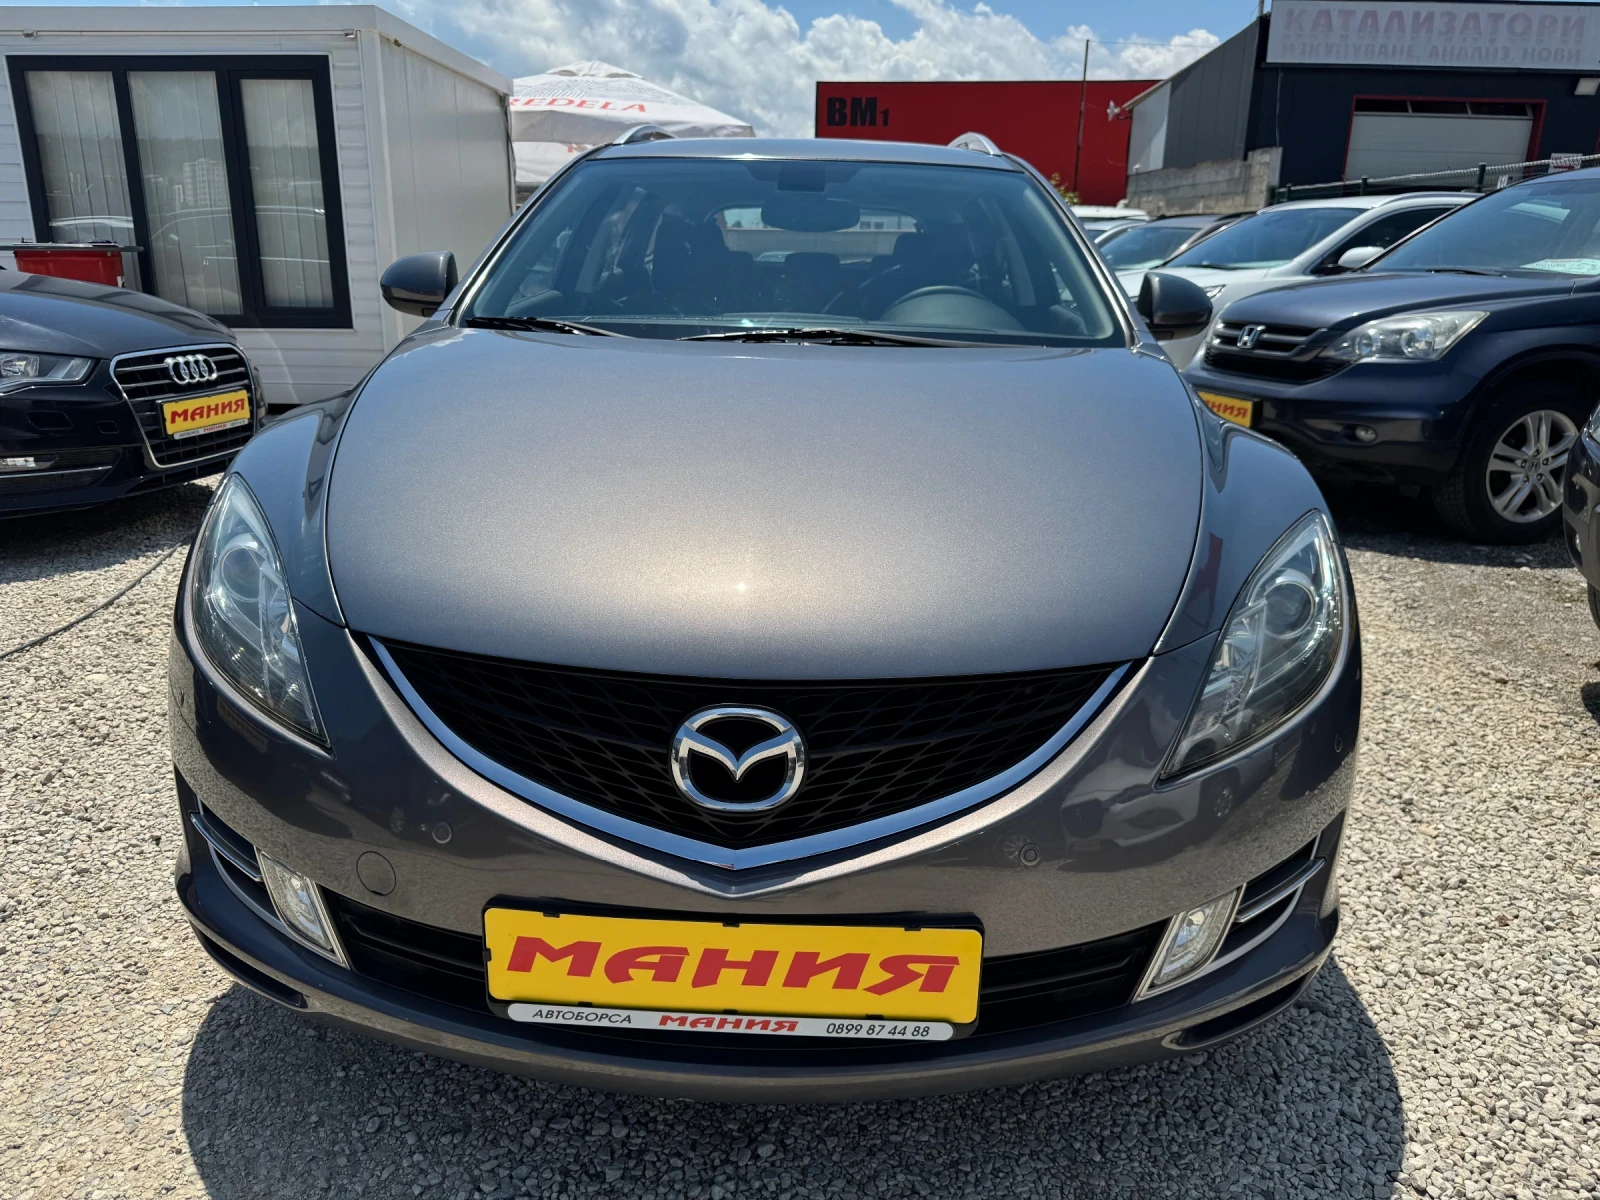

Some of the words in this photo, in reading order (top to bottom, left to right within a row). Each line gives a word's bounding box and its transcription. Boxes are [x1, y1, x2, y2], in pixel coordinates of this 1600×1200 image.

[1285, 8, 1586, 43] КАТАЛИЗАТОРИ
[1521, 47, 1581, 63] НОВИ
[170, 398, 245, 424] МАНИЯ
[506, 936, 961, 996] МАНИЯ
[532, 1009, 632, 1024] АВТОБОРСА
[659, 1014, 799, 1032] МАНИЯ
[826, 1022, 863, 1035] 0899
[866, 1024, 885, 1036] 87
[888, 1025, 907, 1036] 44
[911, 1026, 930, 1037] 88
